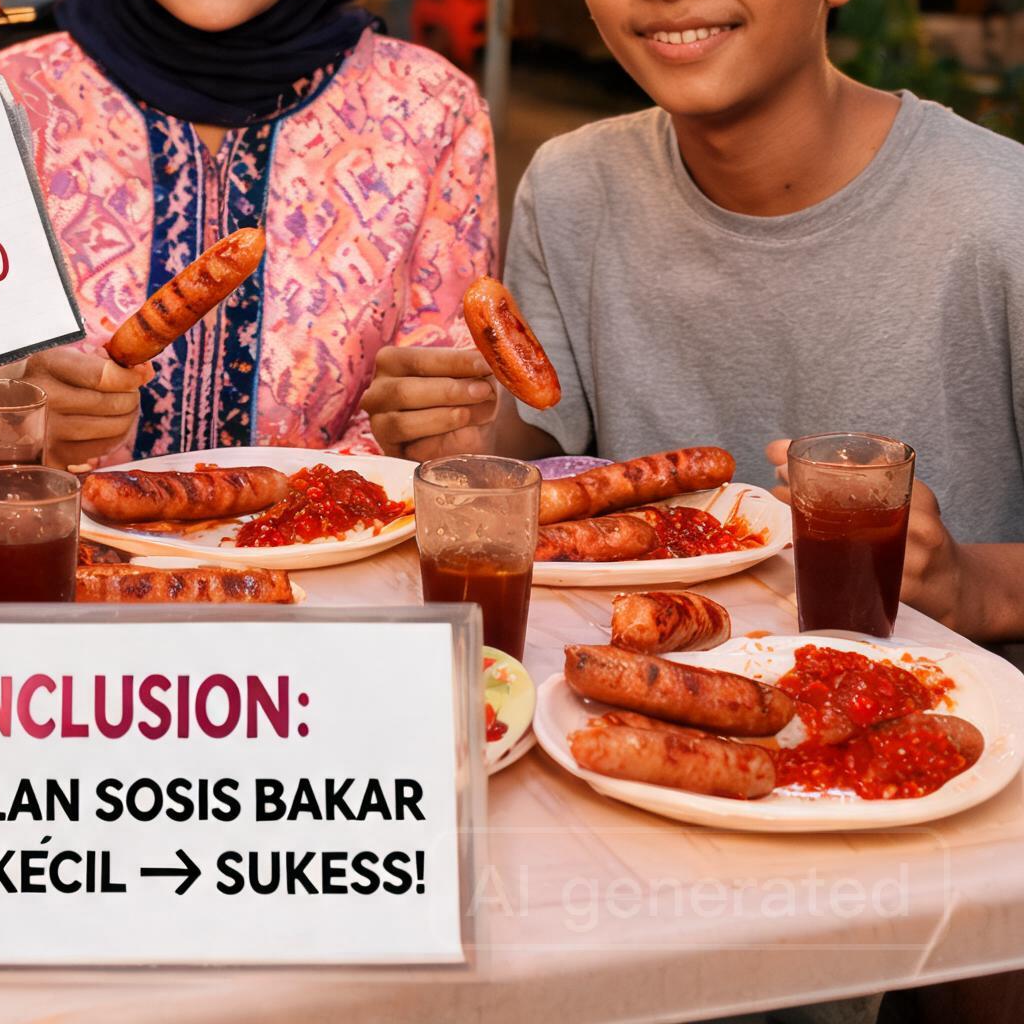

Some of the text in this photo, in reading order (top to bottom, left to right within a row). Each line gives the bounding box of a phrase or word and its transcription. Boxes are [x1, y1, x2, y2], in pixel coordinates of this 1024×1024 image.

[95, 777, 242, 823] SOSIS
[255, 777, 427, 823] BAKAR
[216, 850, 426, 896] SUKESS!
